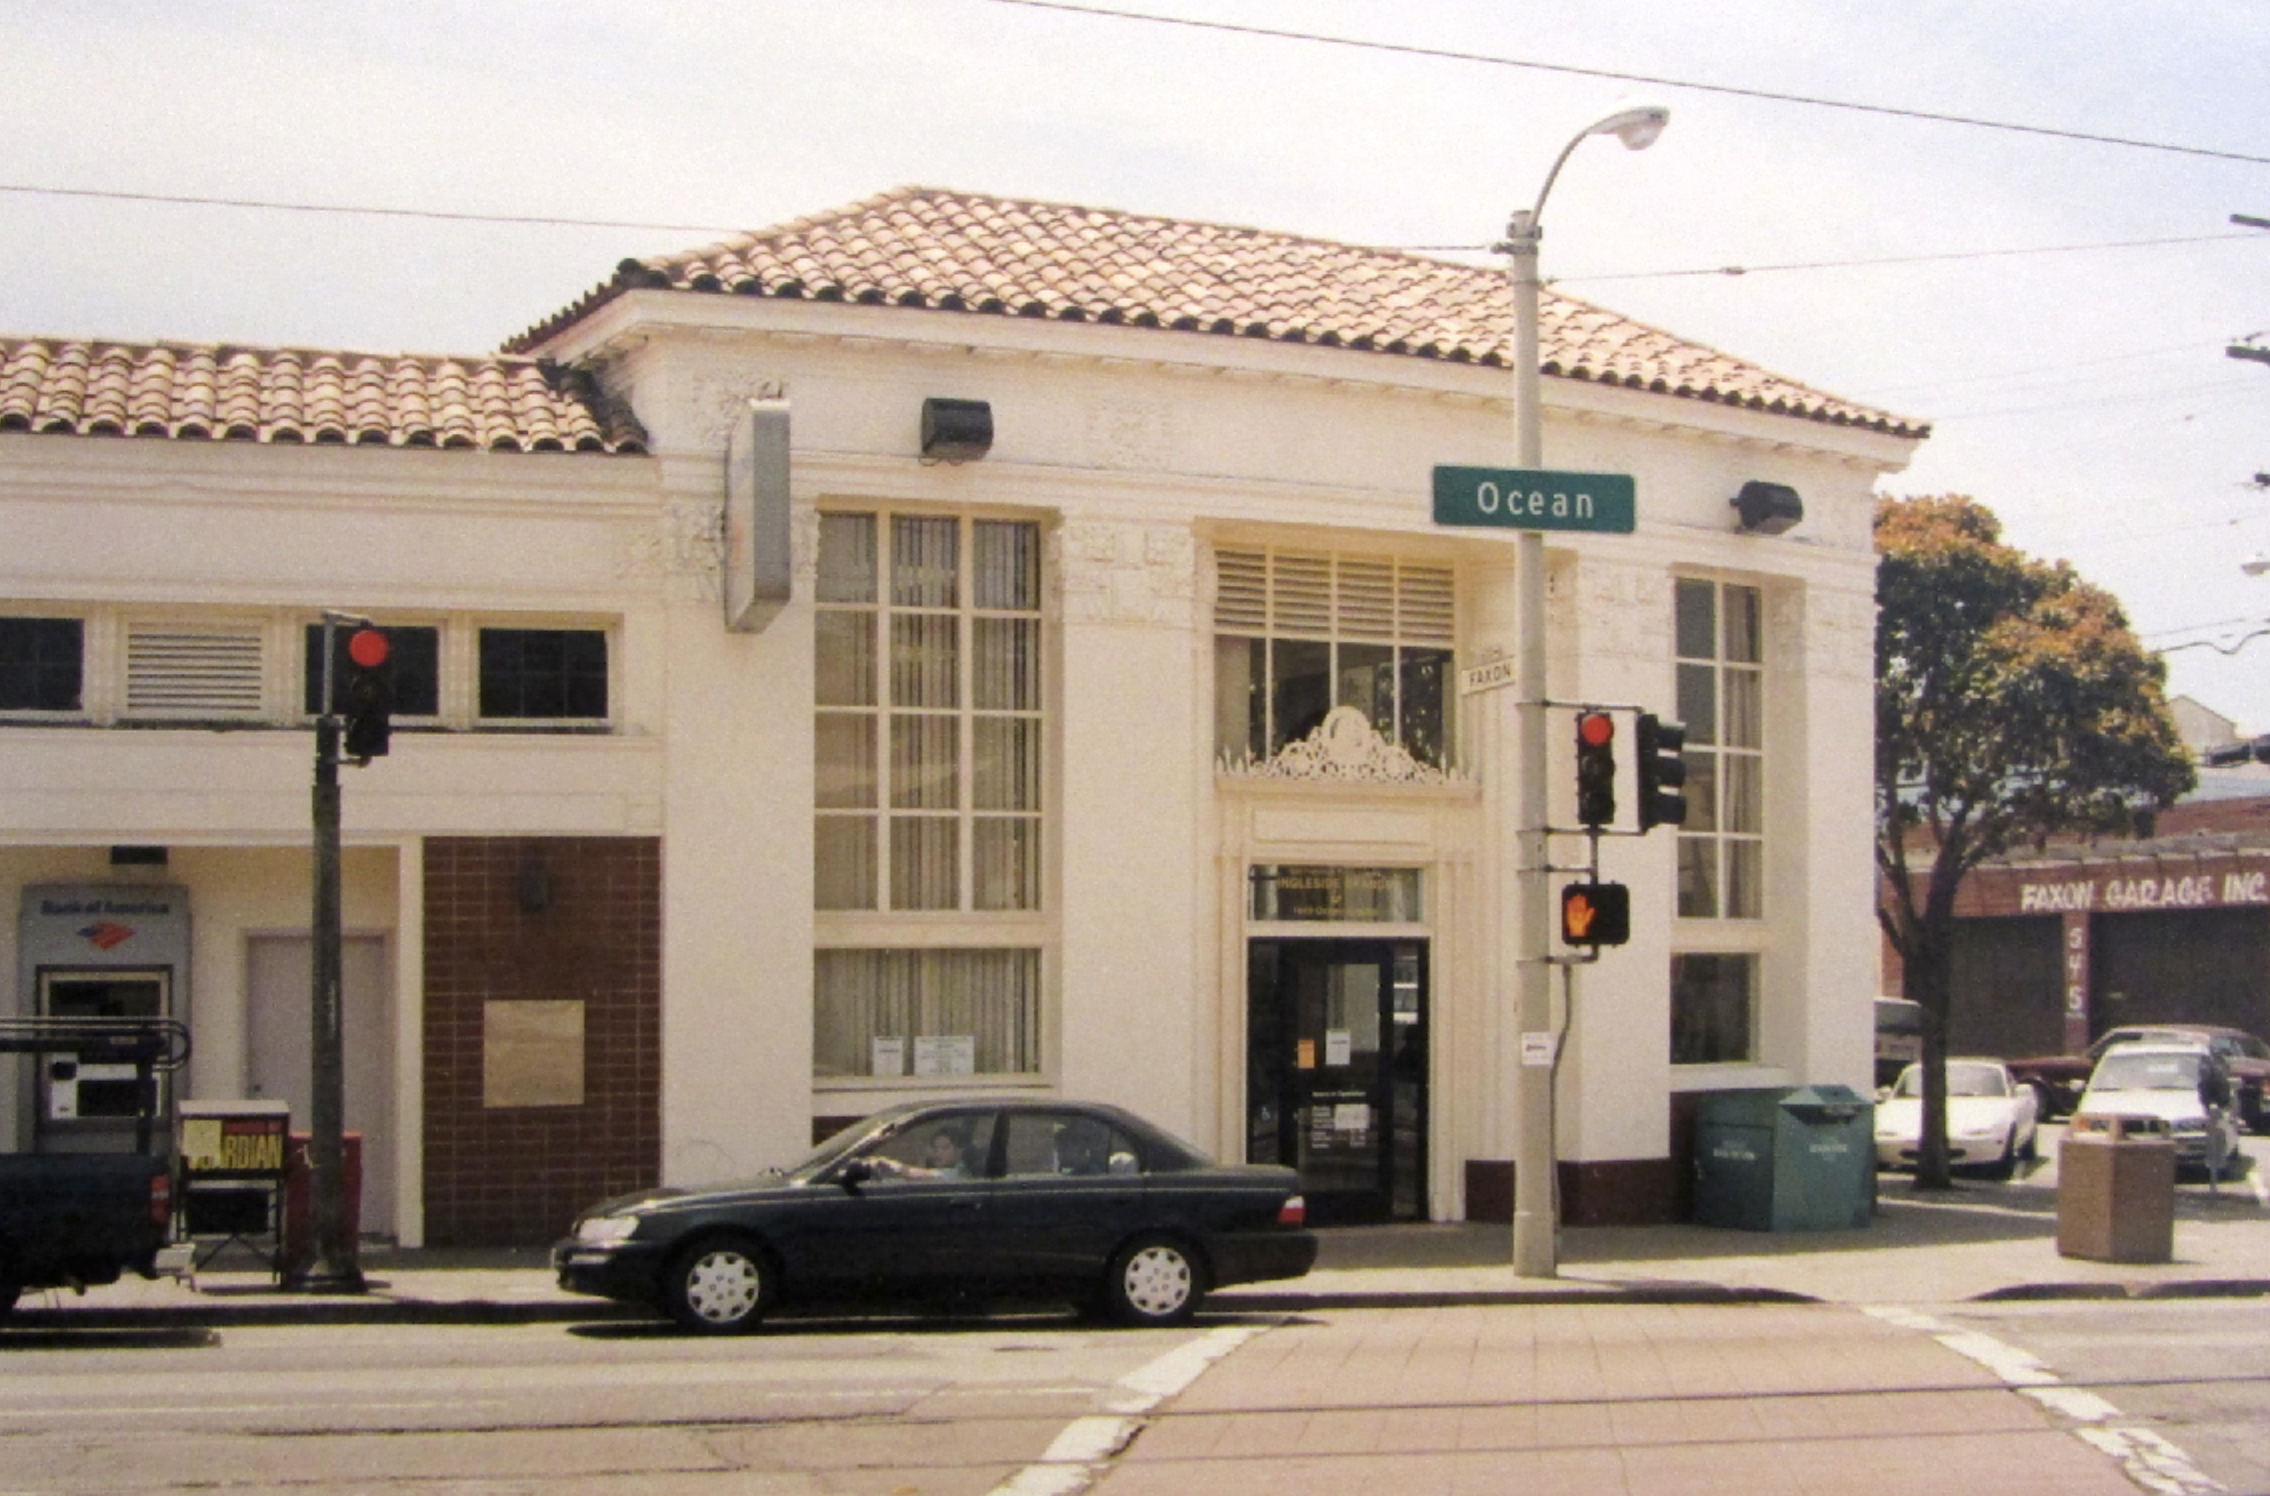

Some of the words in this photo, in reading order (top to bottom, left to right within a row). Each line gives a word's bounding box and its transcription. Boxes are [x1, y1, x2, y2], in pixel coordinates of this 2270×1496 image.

[1476, 481, 1595, 519] Ocean
[1469, 663, 1511, 687] FAXON
[2021, 879, 2095, 911] FAXON
[2105, 875, 2215, 907] GARAGE
